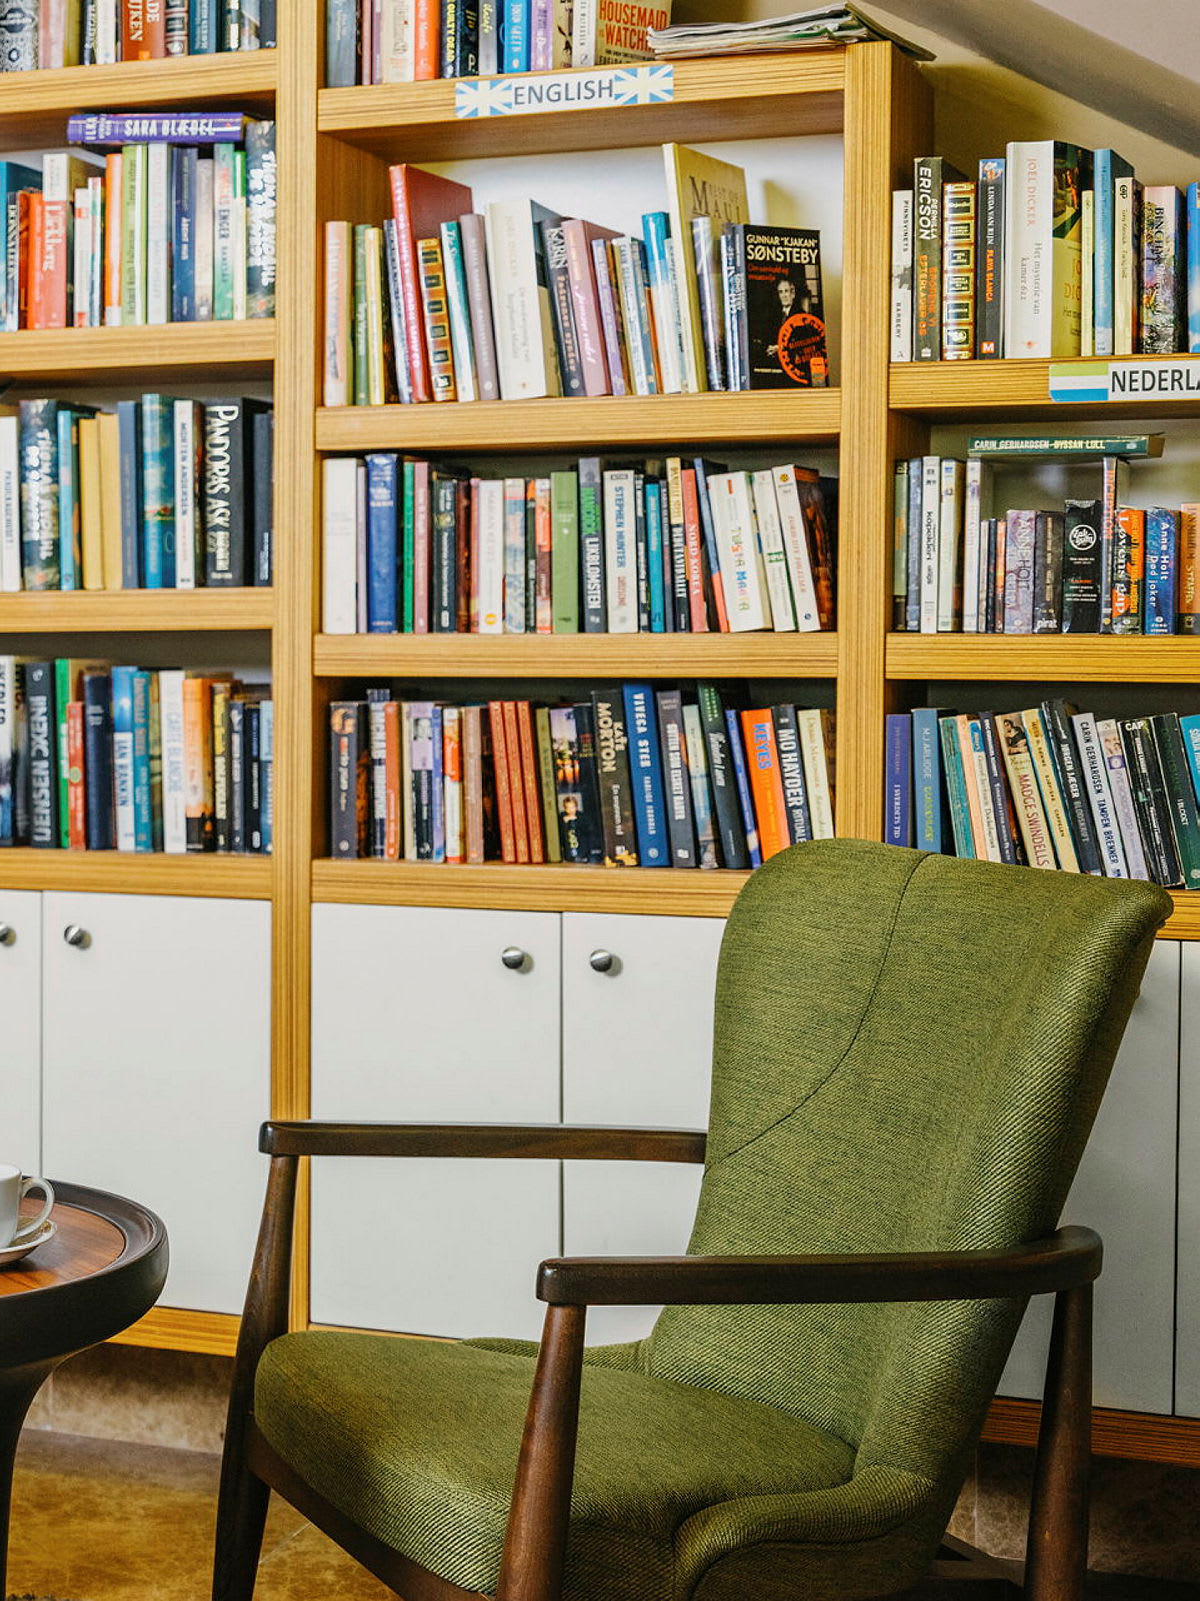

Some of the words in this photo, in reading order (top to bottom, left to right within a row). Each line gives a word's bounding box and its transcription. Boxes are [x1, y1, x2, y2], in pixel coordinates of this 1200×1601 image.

[446, 4, 455, 34] GUILTY
[599, 0, 668, 31] HOUSEMAID
[446, 36, 455, 61] DEAD
[605, 23, 655, 52] WATCH
[513, 78, 615, 105] ENGLISH
[124, 120, 158, 137] SARA
[919, 166, 931, 240] ERICSON
[987, 185, 995, 211] LINDA
[1027, 186, 1036, 227] DICKER
[219, 209, 230, 239] ENGER
[929, 198, 938, 239] PERNILLA
[550, 227, 568, 268] KARIN
[746, 234, 781, 246] GUNNAR
[1154, 207, 1165, 263] BINCHY
[746, 245, 818, 264] SØNSTEBY
[1111, 368, 1200, 392] NEDERL
[205, 405, 238, 494] PANDORAS
[205, 497, 230, 529] ASK
[614, 486, 625, 528] STEPHEN
[1103, 470, 1115, 538] INCEPTION
[616, 530, 626, 568] HUNTER
[1017, 519, 1031, 559] ANNE
[1117, 517, 1129, 579] Løvens
[1160, 522, 1170, 551] Anne
[584, 537, 602, 610] LIKBLOMSTEN
[1017, 559, 1030, 591] HOLT
[1160, 554, 1170, 581] Holt
[1112, 583, 1128, 614] gap
[1148, 579, 1159, 608] joker
[633, 693, 647, 735] VIVECA
[1124, 721, 1149, 731] CAP
[597, 702, 616, 773] MORTON
[613, 721, 627, 752] KATE
[753, 722, 772, 769] KEYES
[777, 728, 795, 752] MO
[1080, 722, 1094, 744] CARIN
[117, 740, 129, 759] IAN
[922, 744, 932, 779] ARLIDGE
[1059, 743, 1074, 771] JØRGEN
[117, 763, 130, 807] RANKIN
[781, 753, 804, 807] HAYDER
[1065, 772, 1080, 799] JÆGER
[1084, 746, 1104, 795] GERHARDSEN
[893, 789, 902, 825] SVERDETS
[1019, 773, 1036, 810] MADGE
[1098, 798, 1111, 829] TAMPEN
[893, 827, 901, 839] TID
[1026, 812, 1050, 866] SWINDELLS
[1104, 831, 1119, 864] BRENNER
